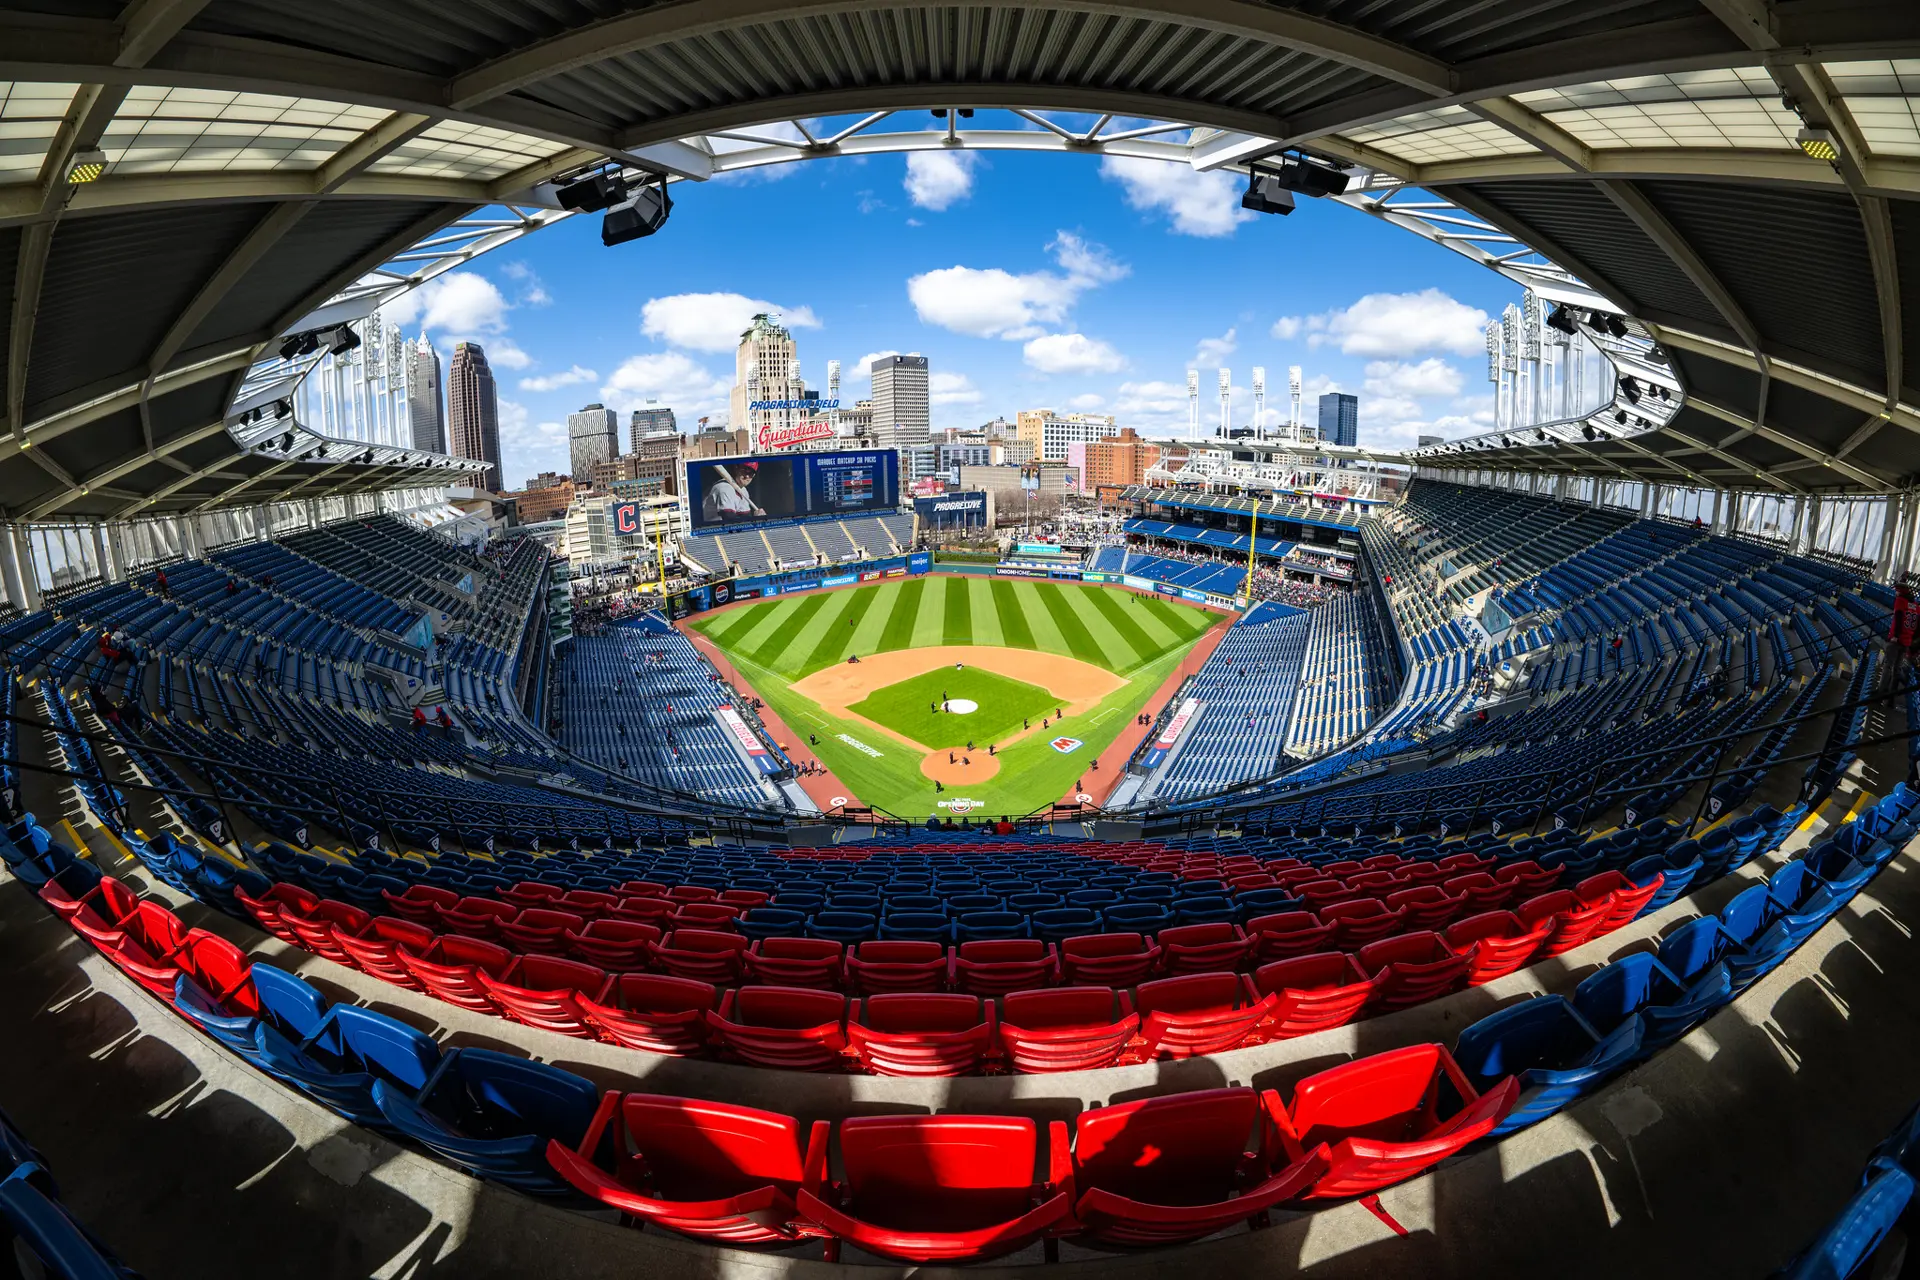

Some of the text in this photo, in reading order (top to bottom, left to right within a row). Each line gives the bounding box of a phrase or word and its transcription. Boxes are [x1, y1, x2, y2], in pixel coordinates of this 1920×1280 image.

[749, 399, 839, 411] PROGRESSIVE FIELD
[758, 421, 831, 449] Guardians
[933, 501, 982, 512] PROGRESSIVE
[617, 504, 637, 532] C
[911, 557, 928, 566] meijer
[823, 576, 854, 586] PROGRESSIVE
